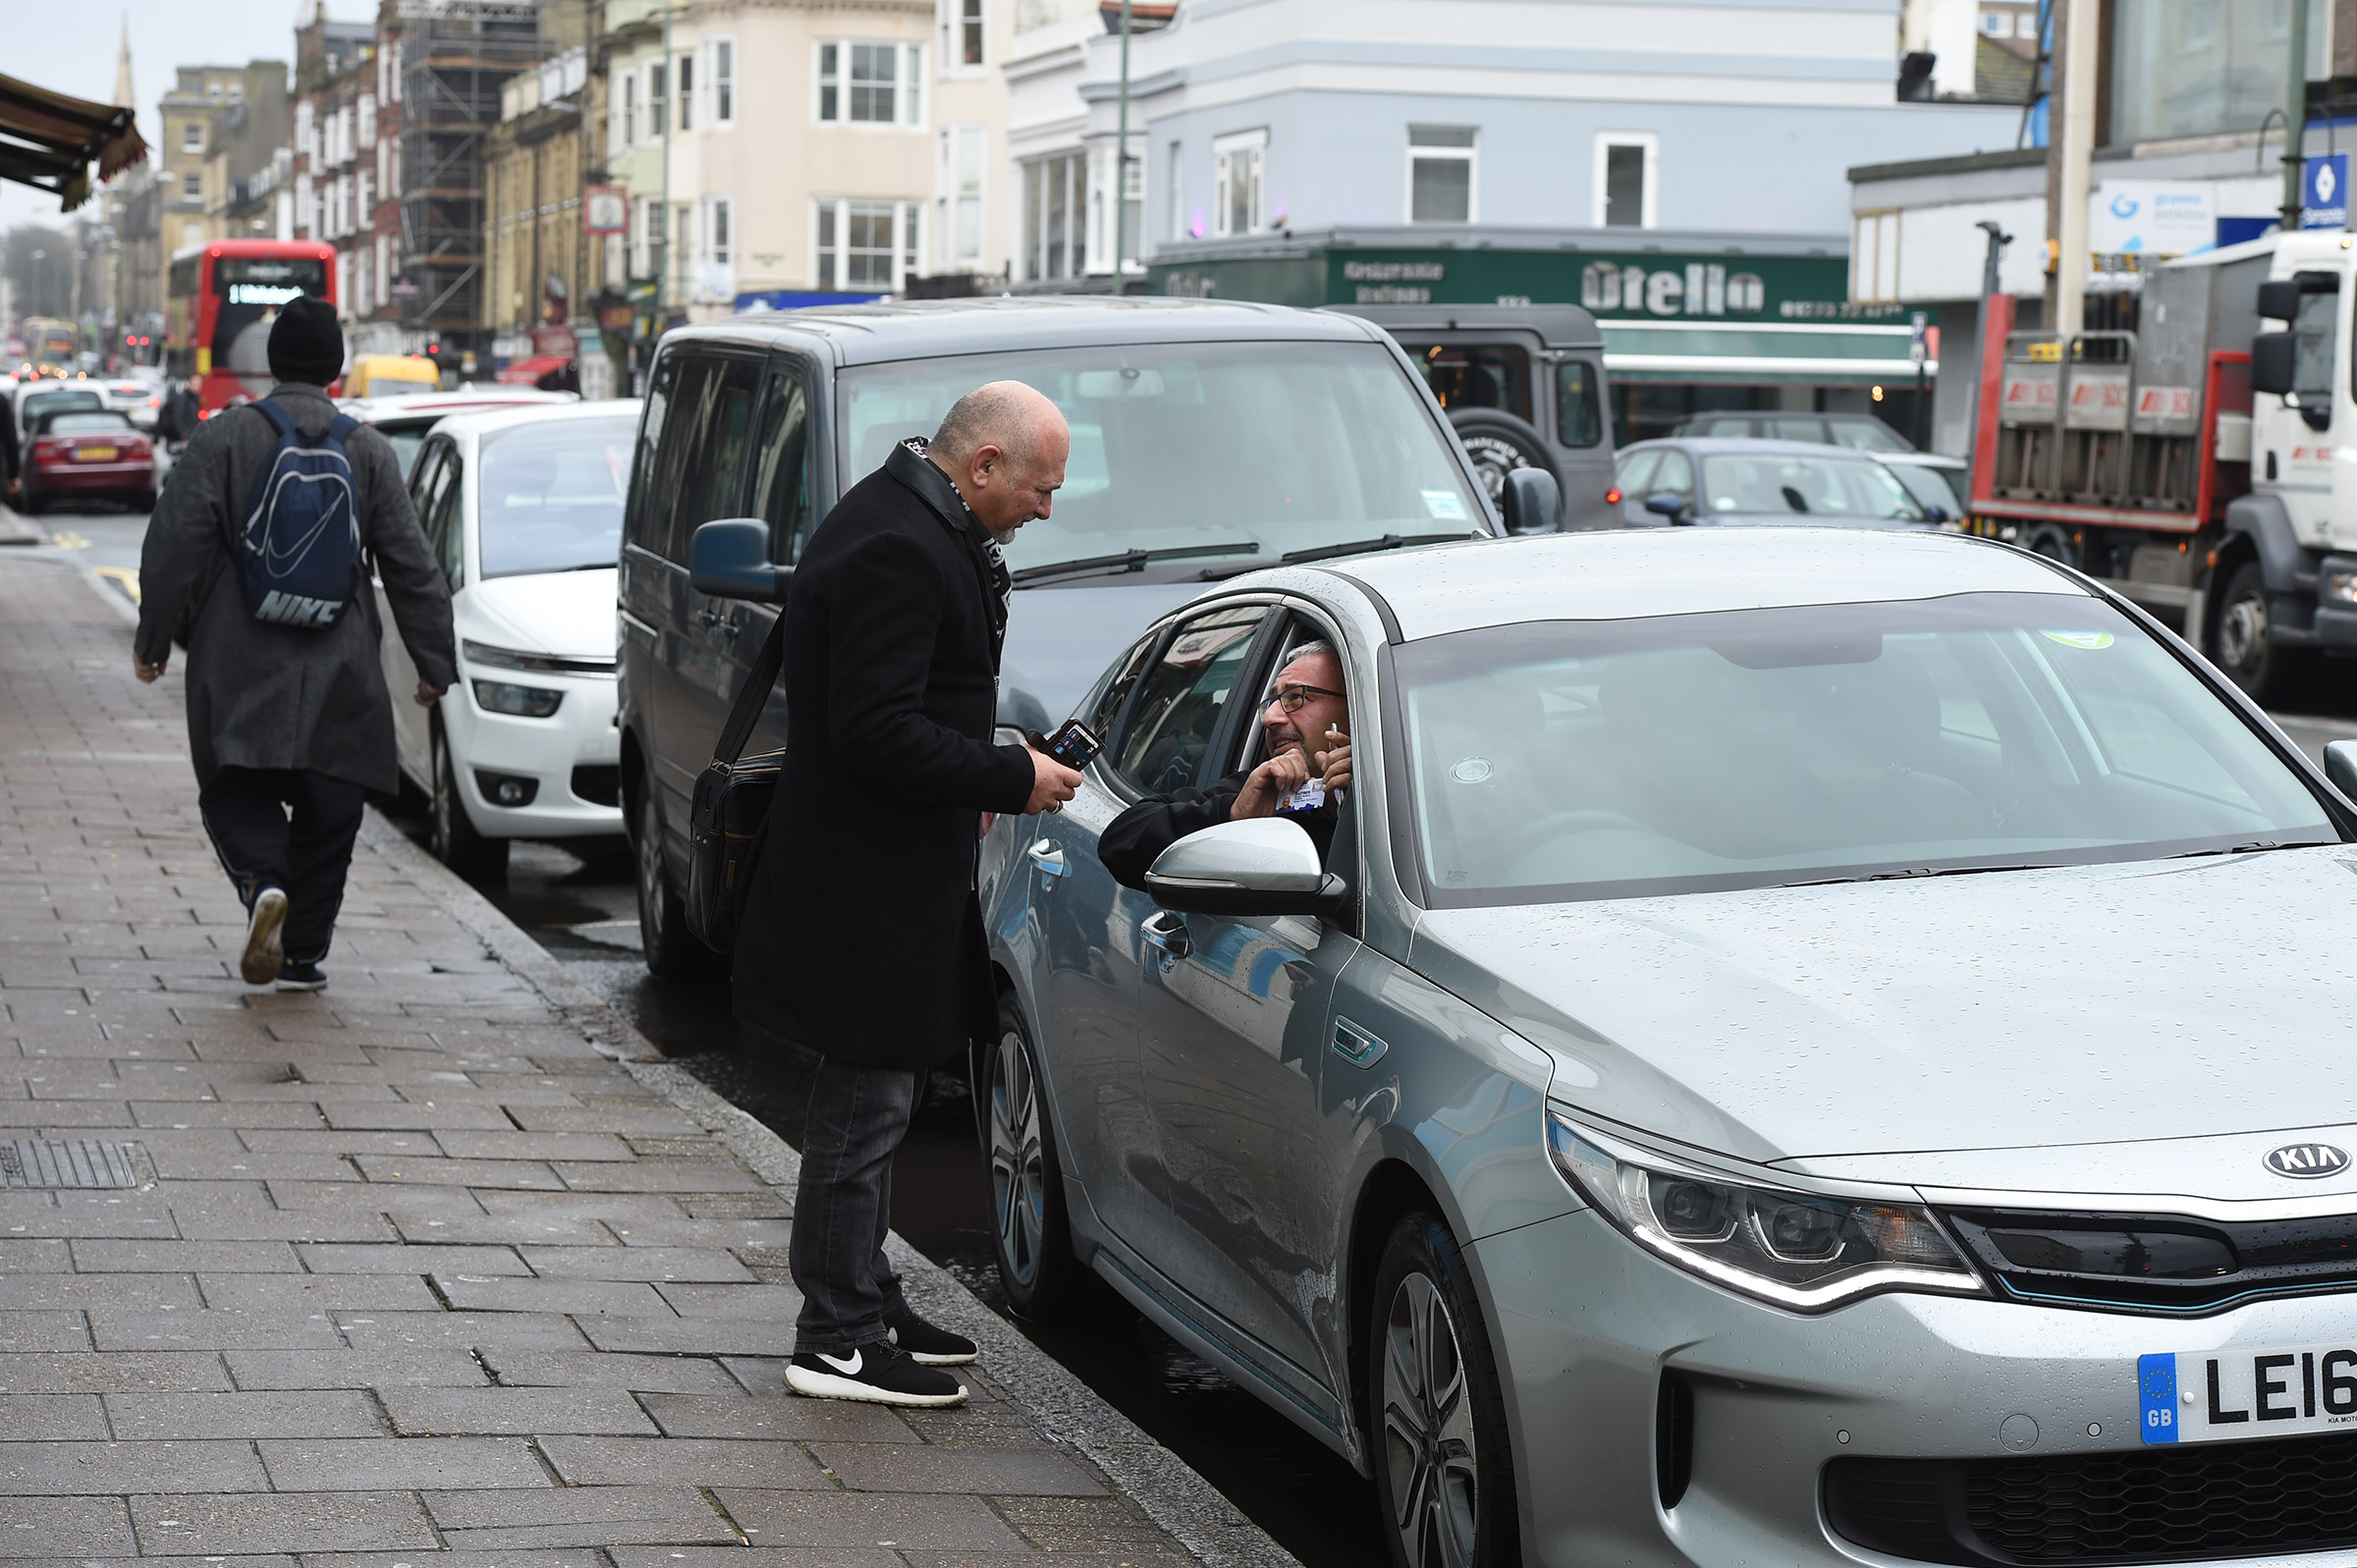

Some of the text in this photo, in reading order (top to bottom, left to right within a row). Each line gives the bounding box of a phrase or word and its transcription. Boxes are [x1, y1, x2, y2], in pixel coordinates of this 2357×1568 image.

[1581, 261, 1765, 316] Otello
[254, 589, 344, 628] NIKE
[2275, 1146, 2342, 1170] KIA
[2147, 1408, 2173, 1429] GB
